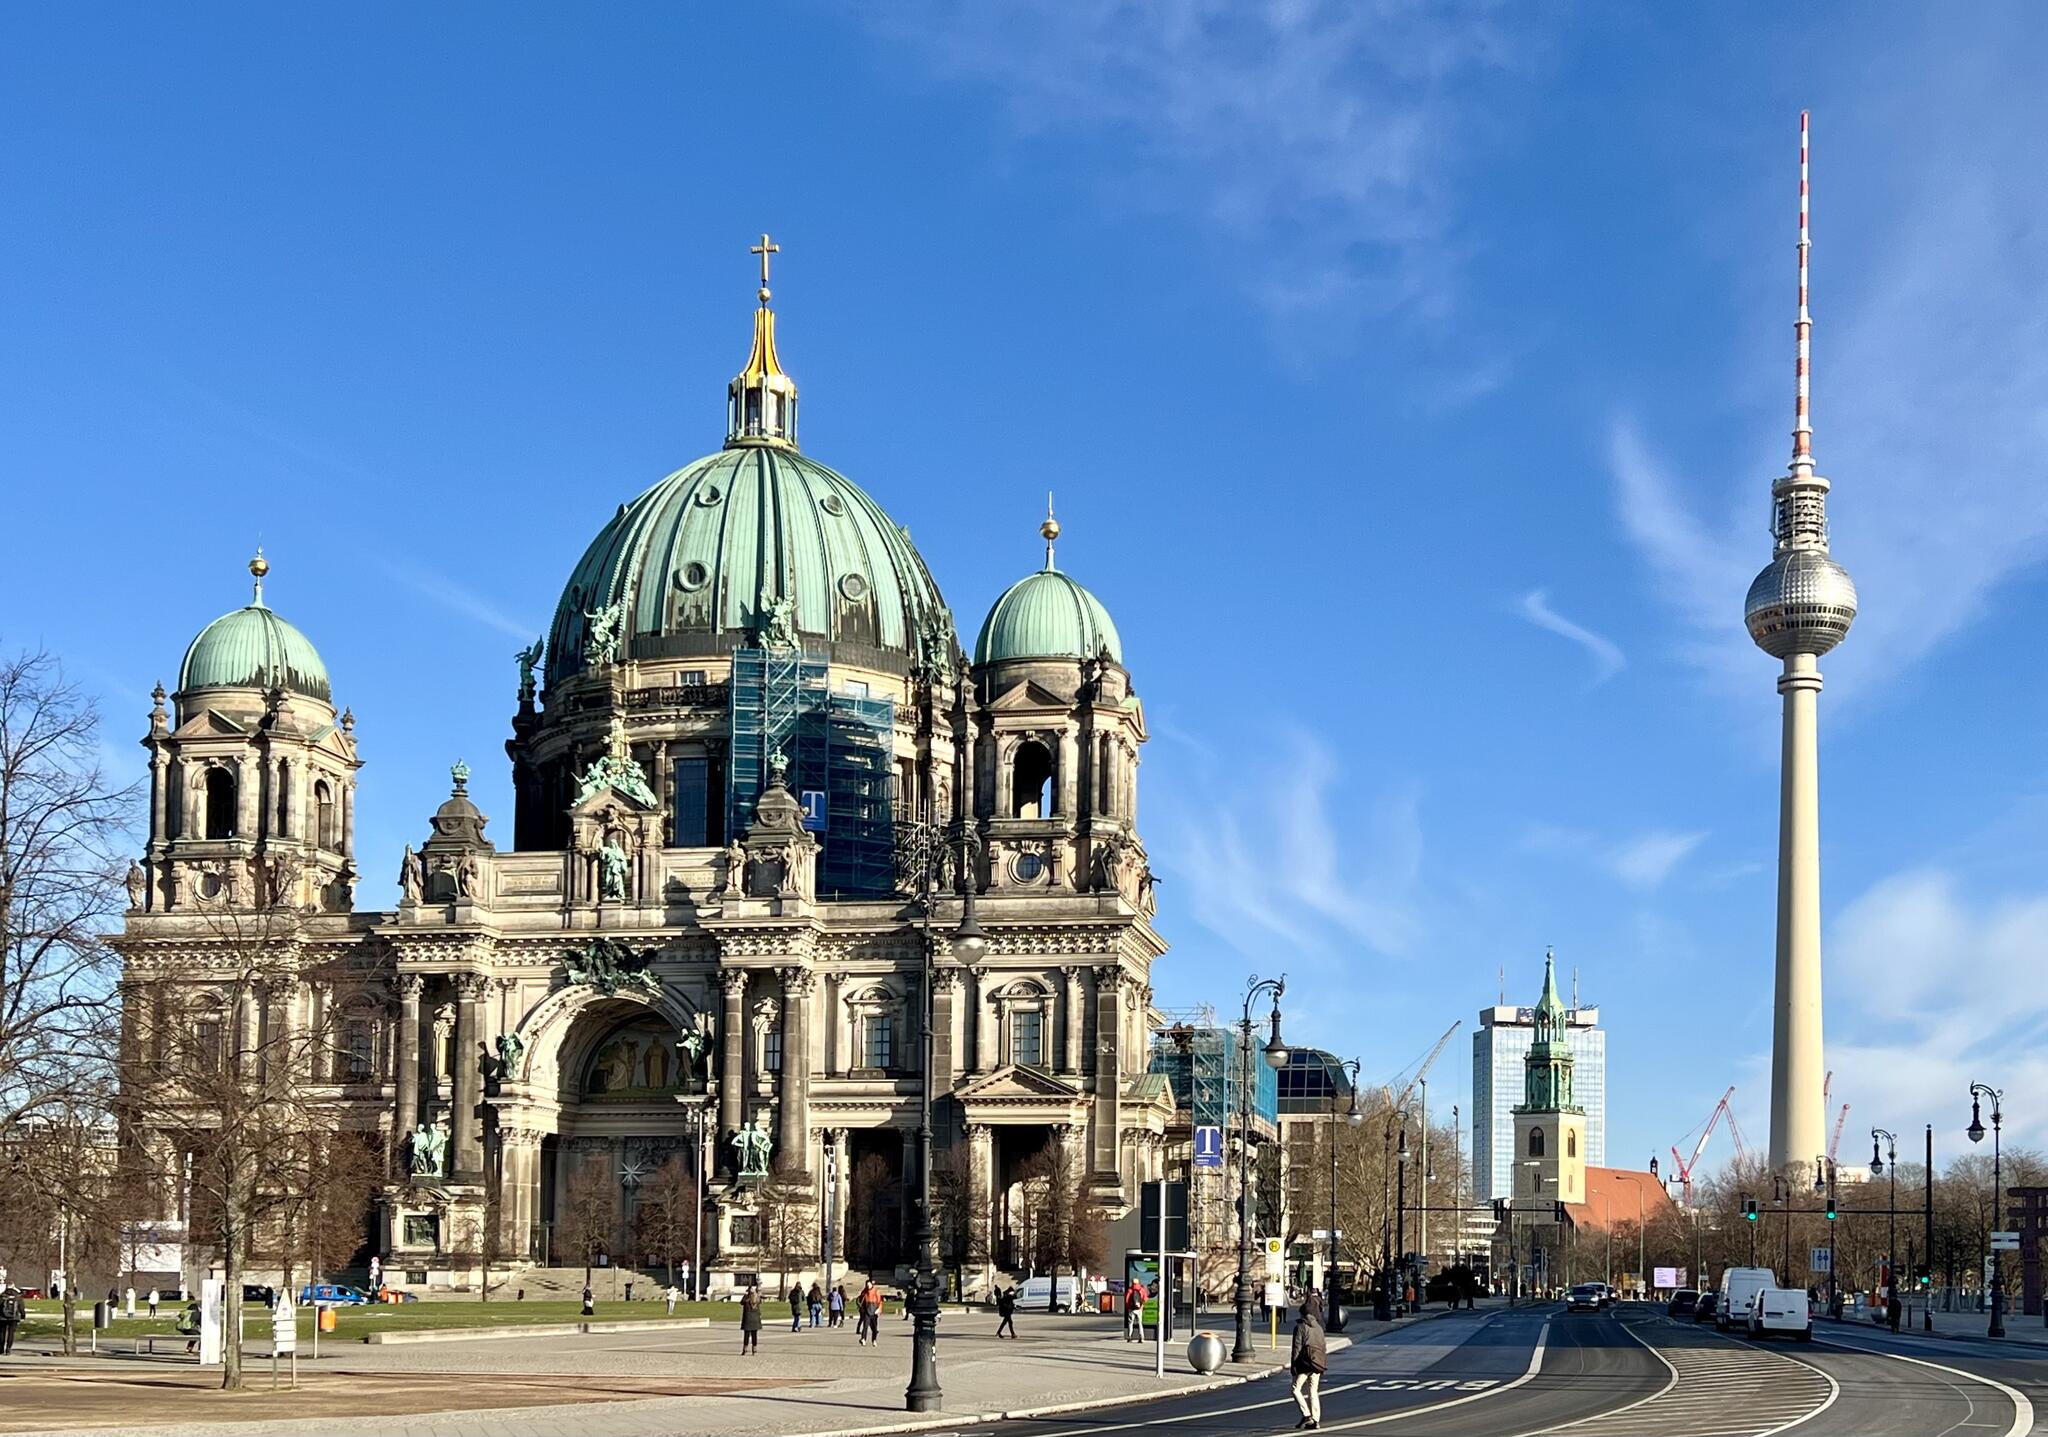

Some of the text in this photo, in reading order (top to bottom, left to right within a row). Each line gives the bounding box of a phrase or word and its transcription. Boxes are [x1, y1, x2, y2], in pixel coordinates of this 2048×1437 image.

[802, 791, 825, 819] T
[1196, 1125, 1220, 1154] T
[1366, 1379, 1500, 1391] BUS
